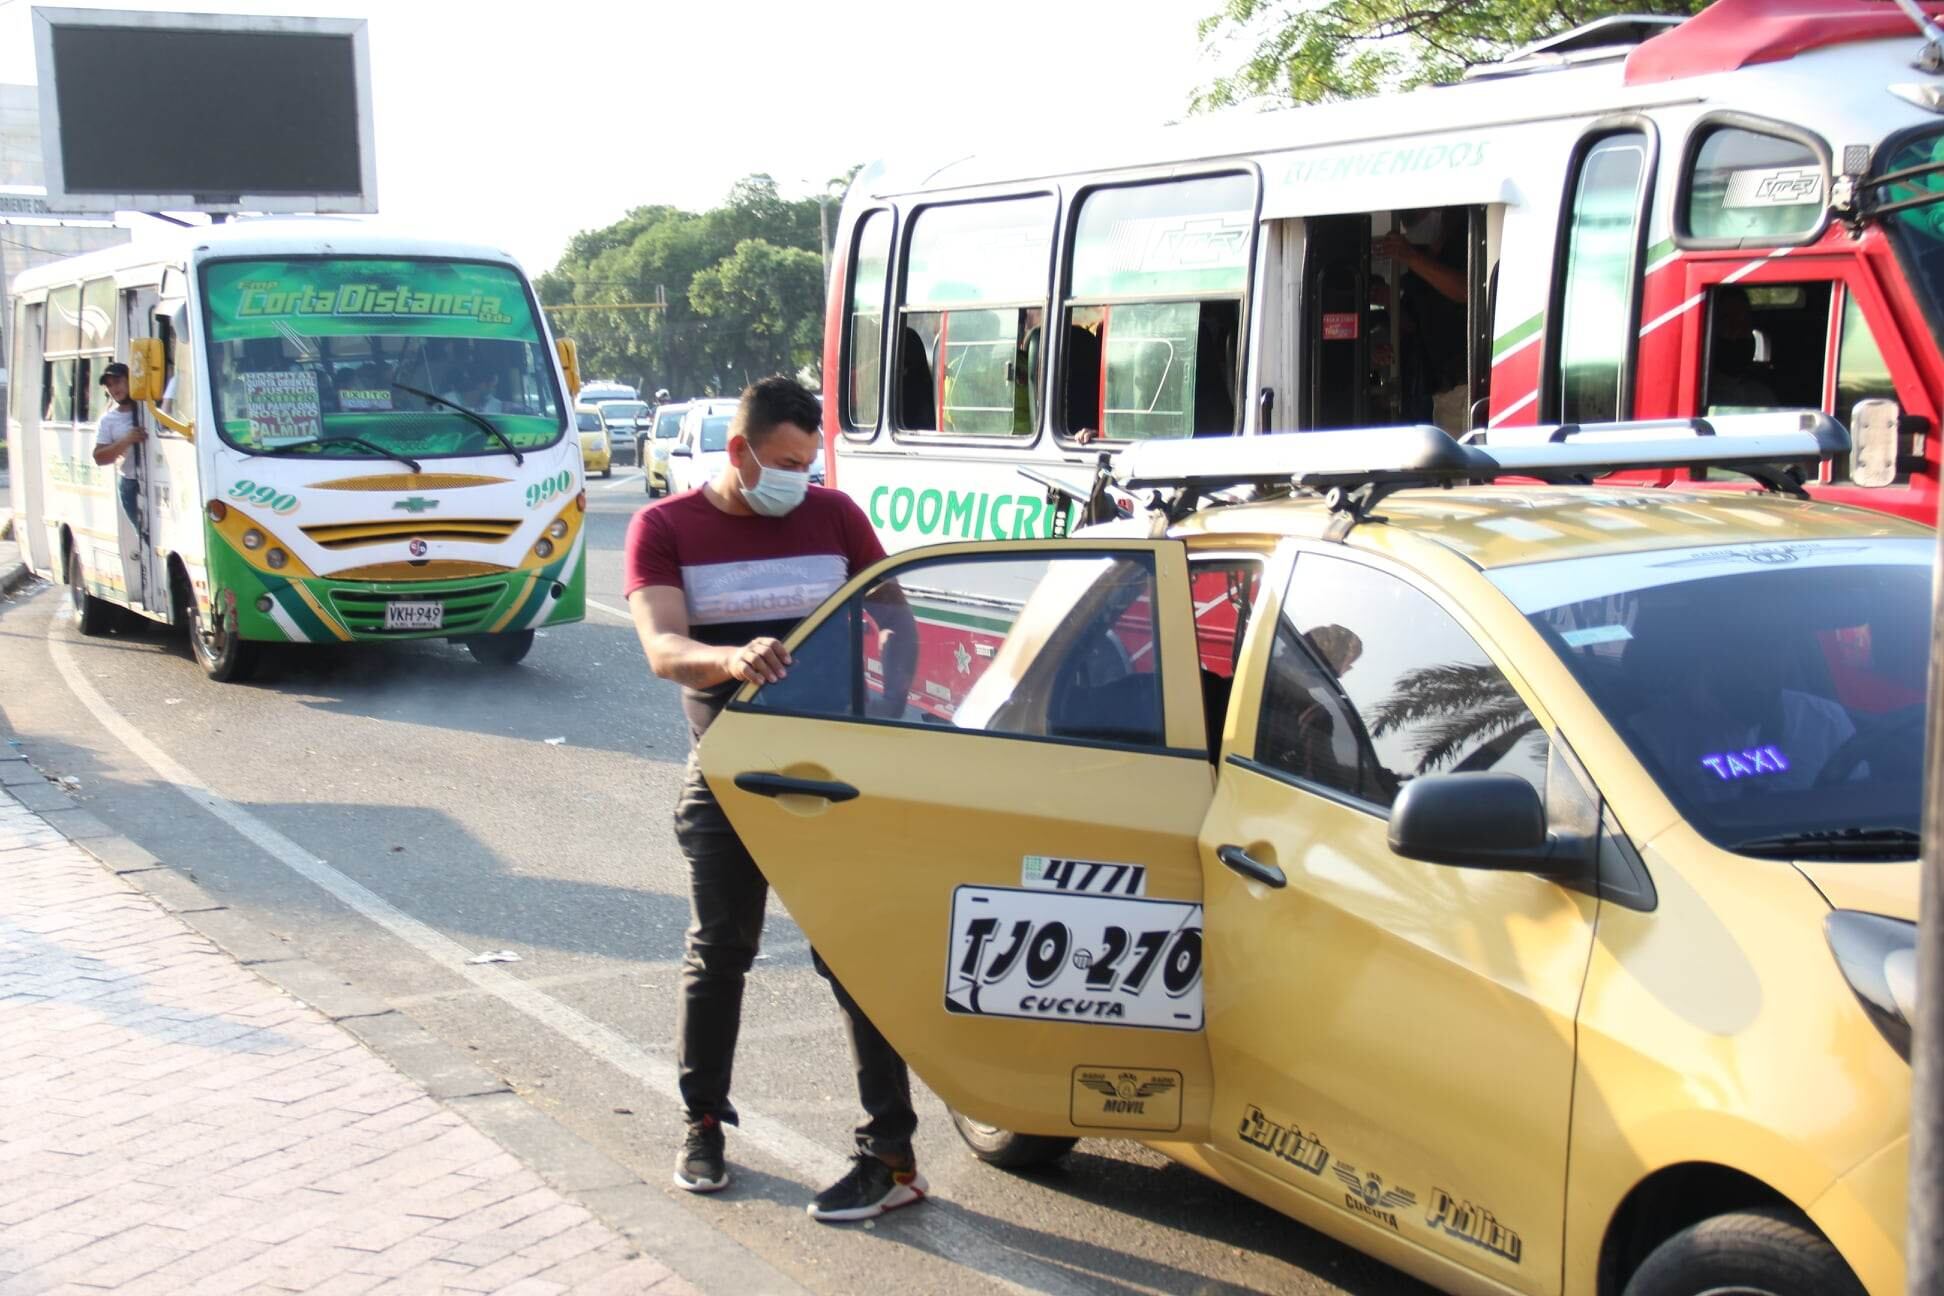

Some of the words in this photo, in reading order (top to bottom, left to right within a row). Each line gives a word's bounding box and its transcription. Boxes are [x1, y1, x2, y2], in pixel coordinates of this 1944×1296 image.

[1283, 140, 1490, 185] BIENVENIDOS
[335, 284, 501, 316] Distancia
[246, 372, 317, 381] HOSPITAL
[250, 420, 320, 437] PALMITA
[228, 480, 299, 513] 990
[527, 470, 570, 507] 990
[1701, 746, 1786, 780] TAXI
[960, 917, 1072, 987] TJO
[1086, 925, 1203, 998] 270
[1019, 996, 1126, 1018] CUCUTA
[1103, 1099, 1144, 1114] MOVIL
[1344, 1193, 1399, 1231] CUCUTA
